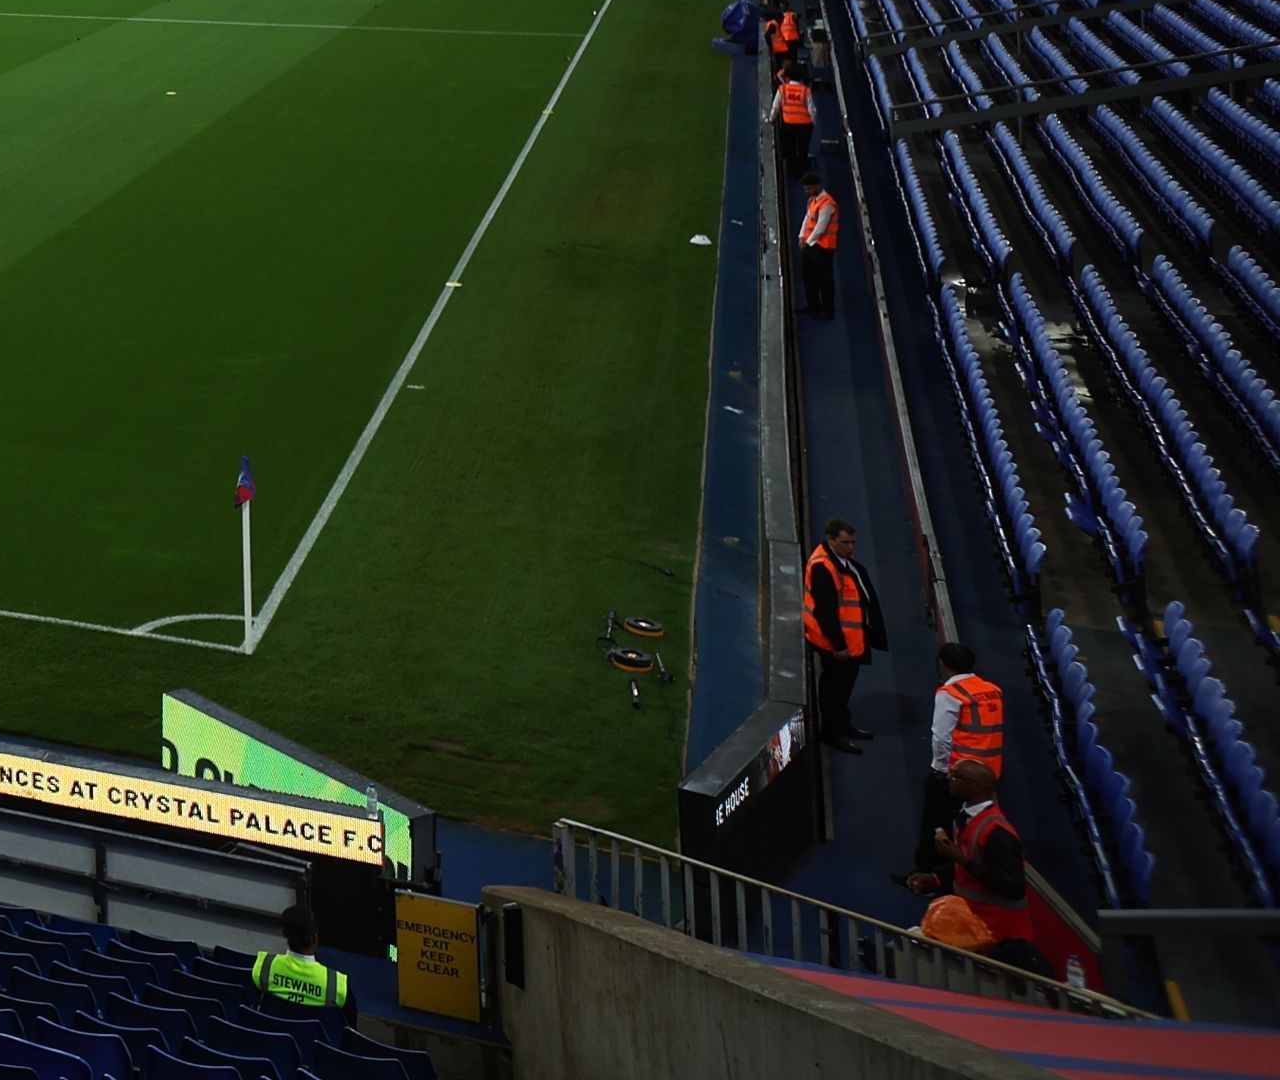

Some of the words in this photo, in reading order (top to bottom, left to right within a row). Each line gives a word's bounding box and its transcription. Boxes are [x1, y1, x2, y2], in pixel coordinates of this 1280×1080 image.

[725, 776, 750, 817] HOUSE
[69, 781, 98, 800] AT
[107, 786, 220, 823] CRYSTAL
[230, 808, 333, 845] PALACE
[397, 919, 477, 945] EMERGENCY
[423, 936, 451, 951] EXIT
[420, 948, 455, 964] KEEP
[416, 960, 460, 978] CLEAR
[272, 973, 322, 997] STEWARD
